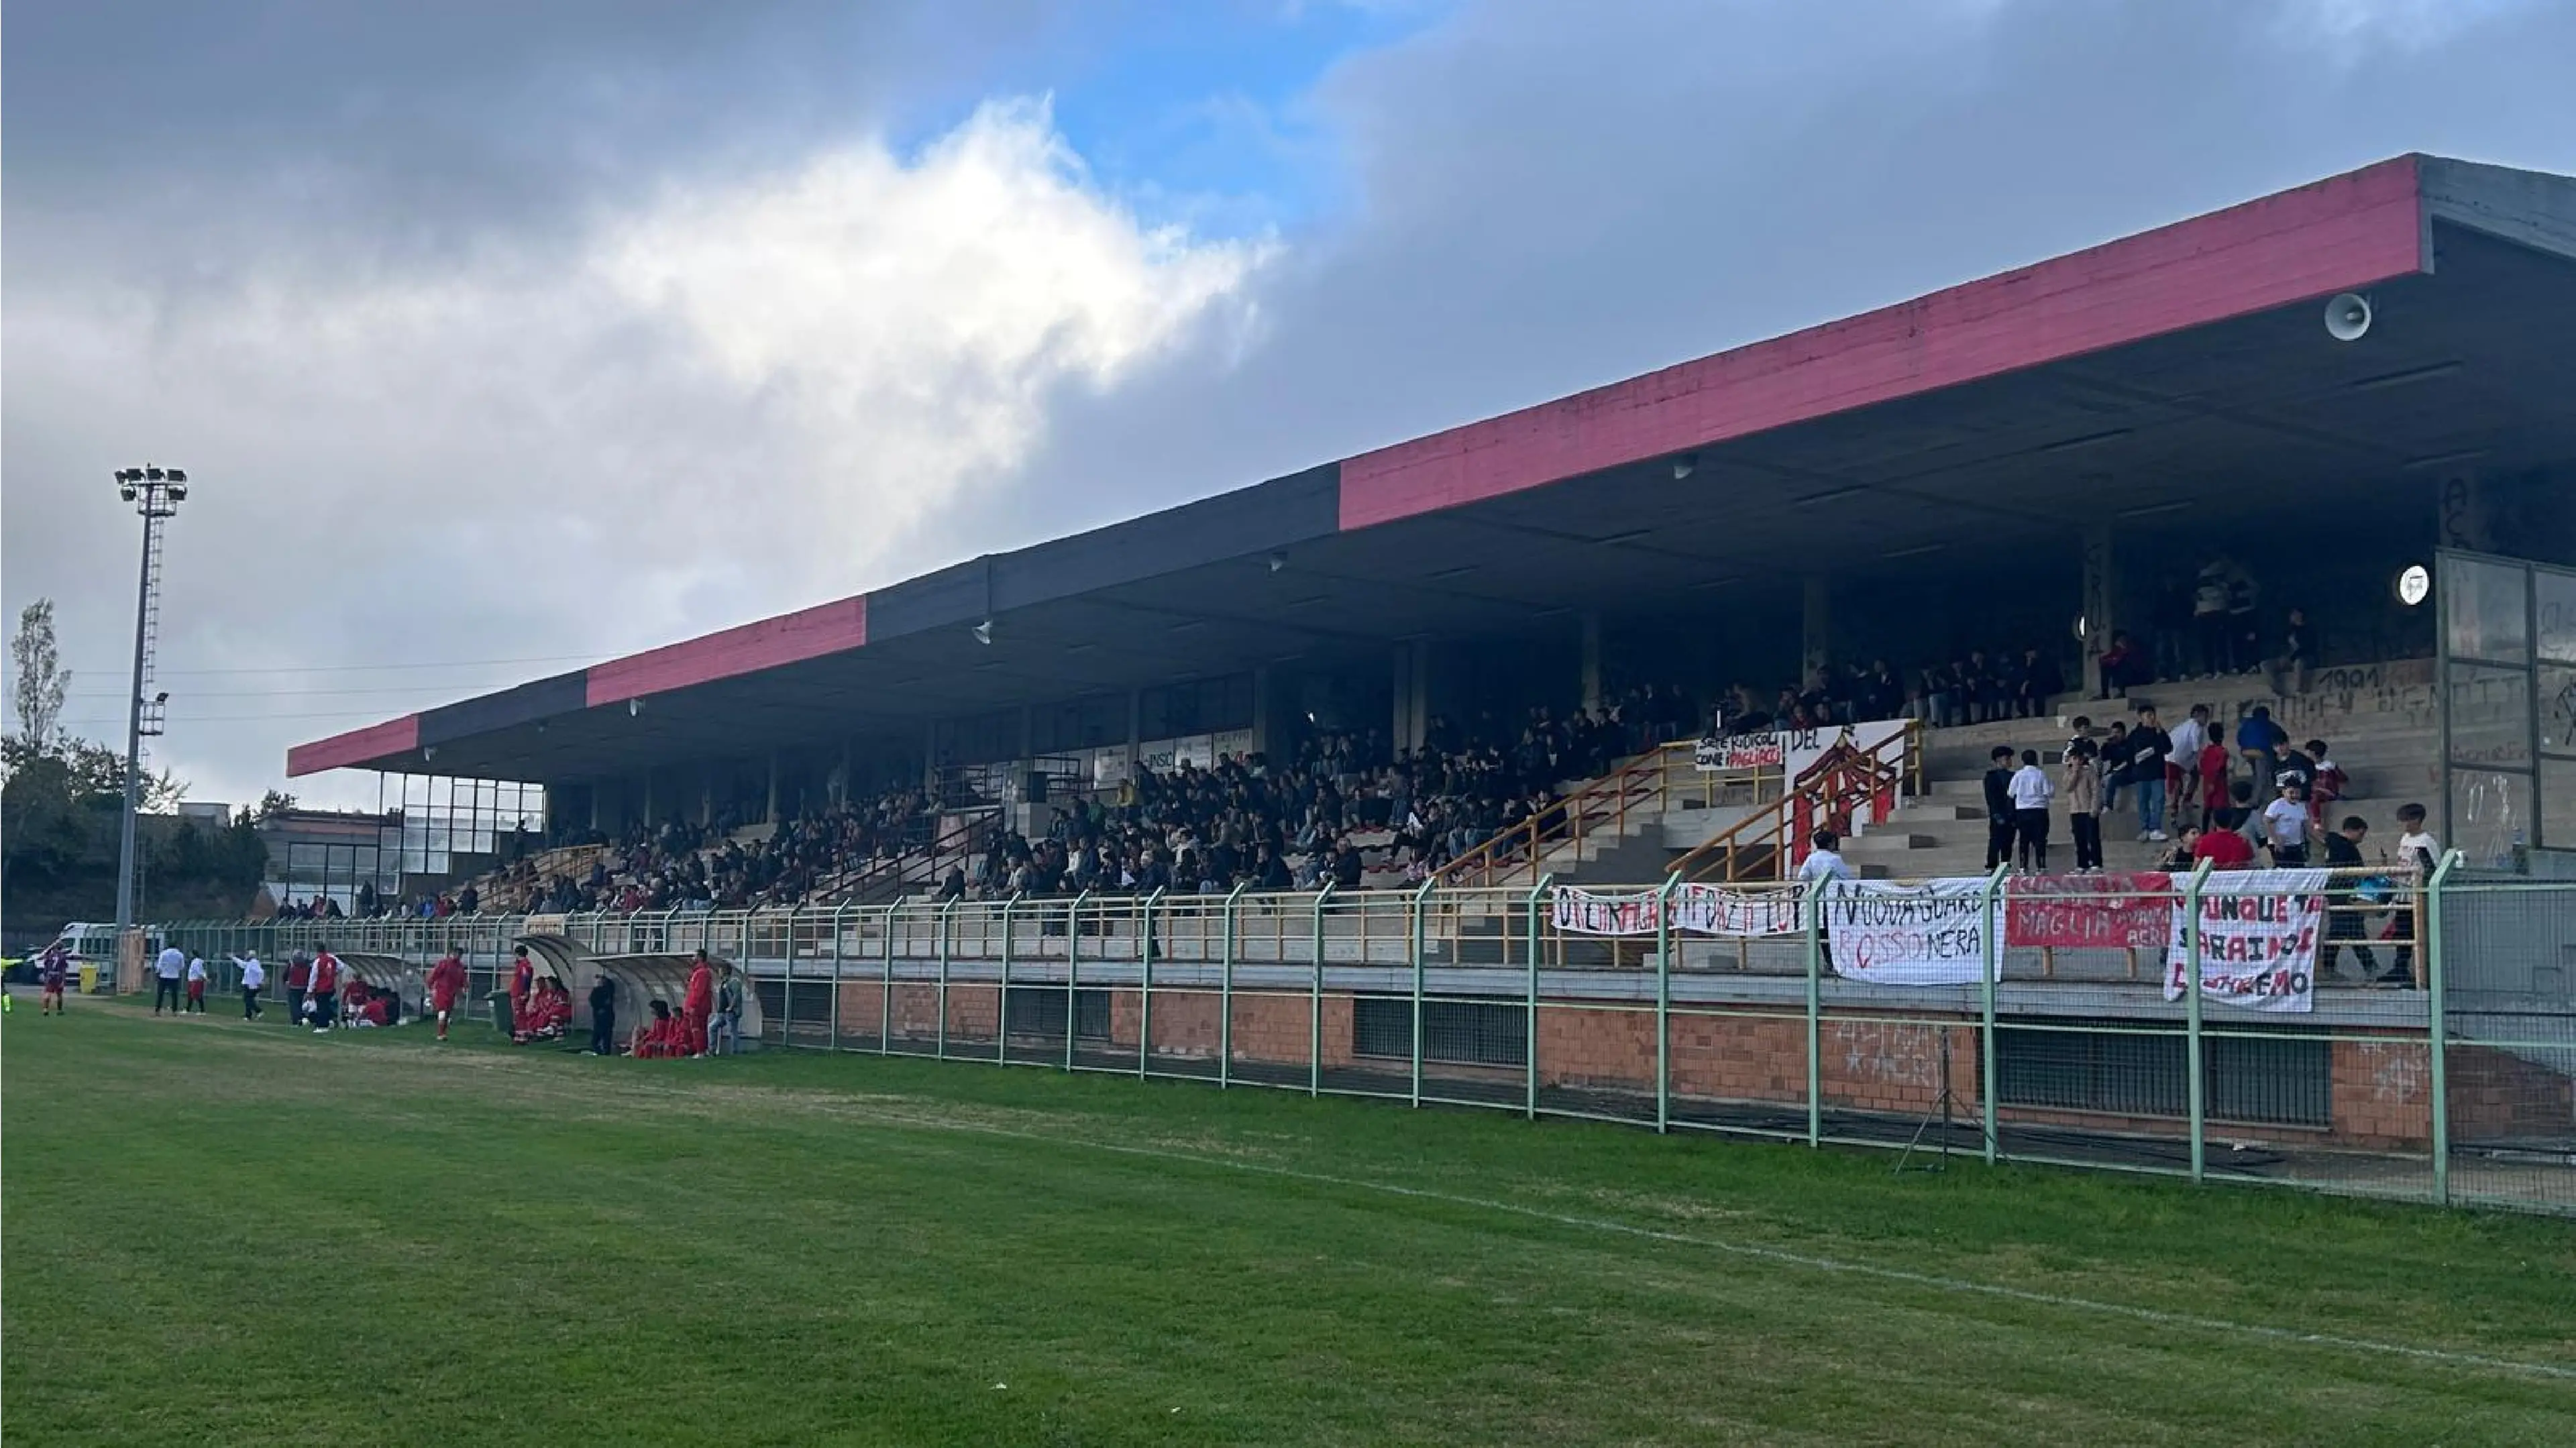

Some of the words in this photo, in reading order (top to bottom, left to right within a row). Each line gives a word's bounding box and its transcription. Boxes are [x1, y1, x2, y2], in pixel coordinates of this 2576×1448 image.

[1791, 728, 1821, 751] DEL
[1766, 884, 1807, 932] LUP
[1835, 883, 1915, 926] NUOVA
[1919, 885, 2002, 922] GUARDA
[2175, 895, 2288, 924] UNQUE
